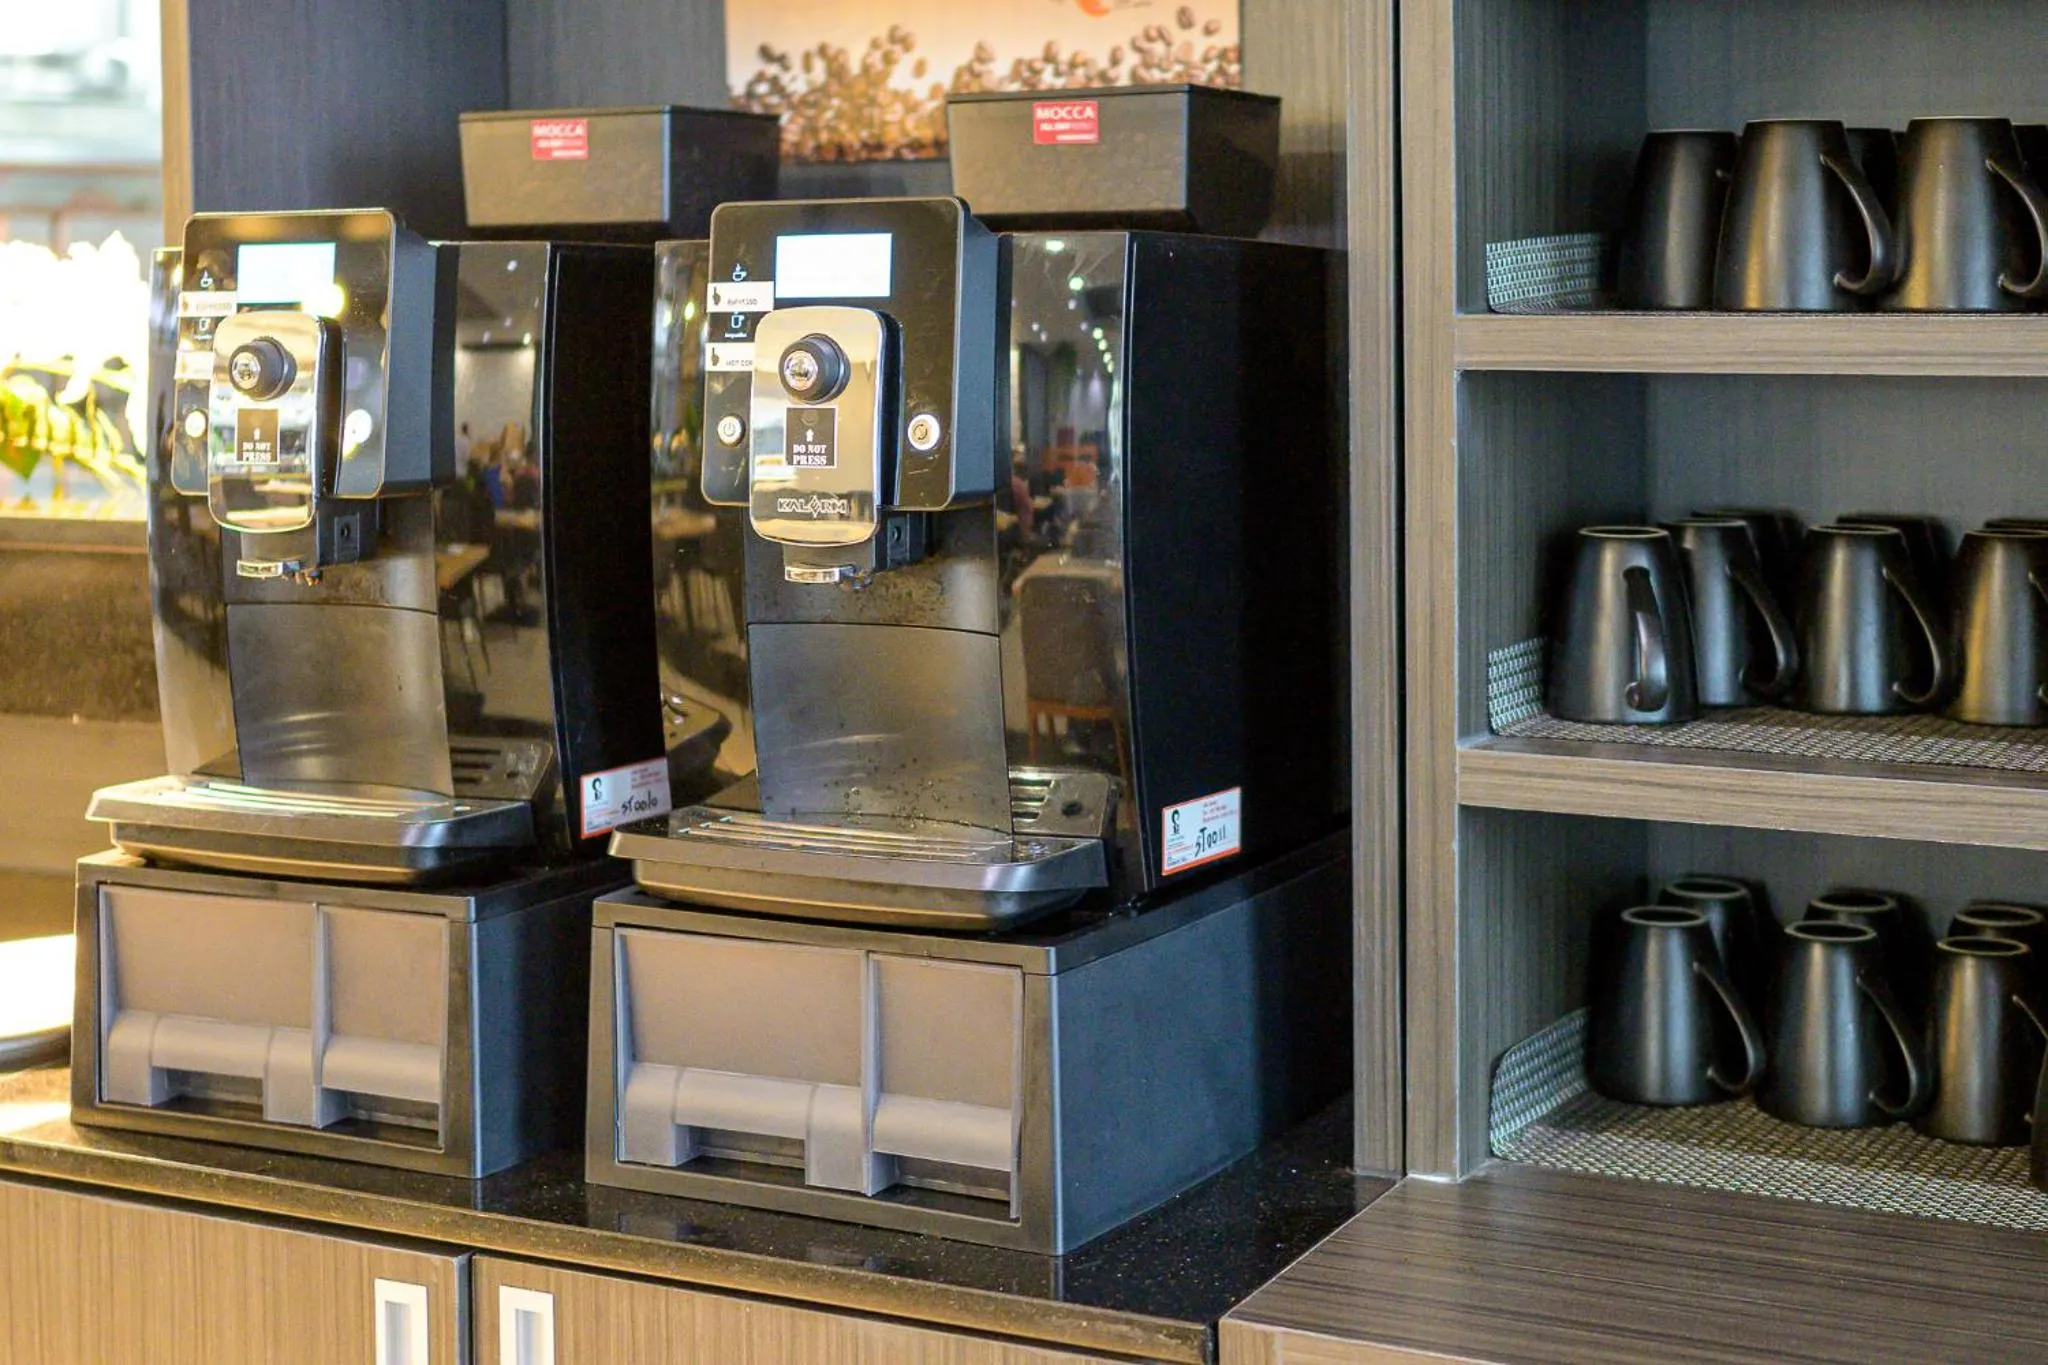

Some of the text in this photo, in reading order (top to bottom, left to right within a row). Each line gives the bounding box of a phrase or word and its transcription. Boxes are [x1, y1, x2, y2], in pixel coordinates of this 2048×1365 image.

[1035, 105, 1095, 119] MOCCA
[533, 123, 583, 137] MOCCA
[243, 441, 271, 451] DO NOT
[793, 444, 827, 454] DO NOT
[243, 452, 272, 463] PRESS
[792, 455, 827, 465] PRESS
